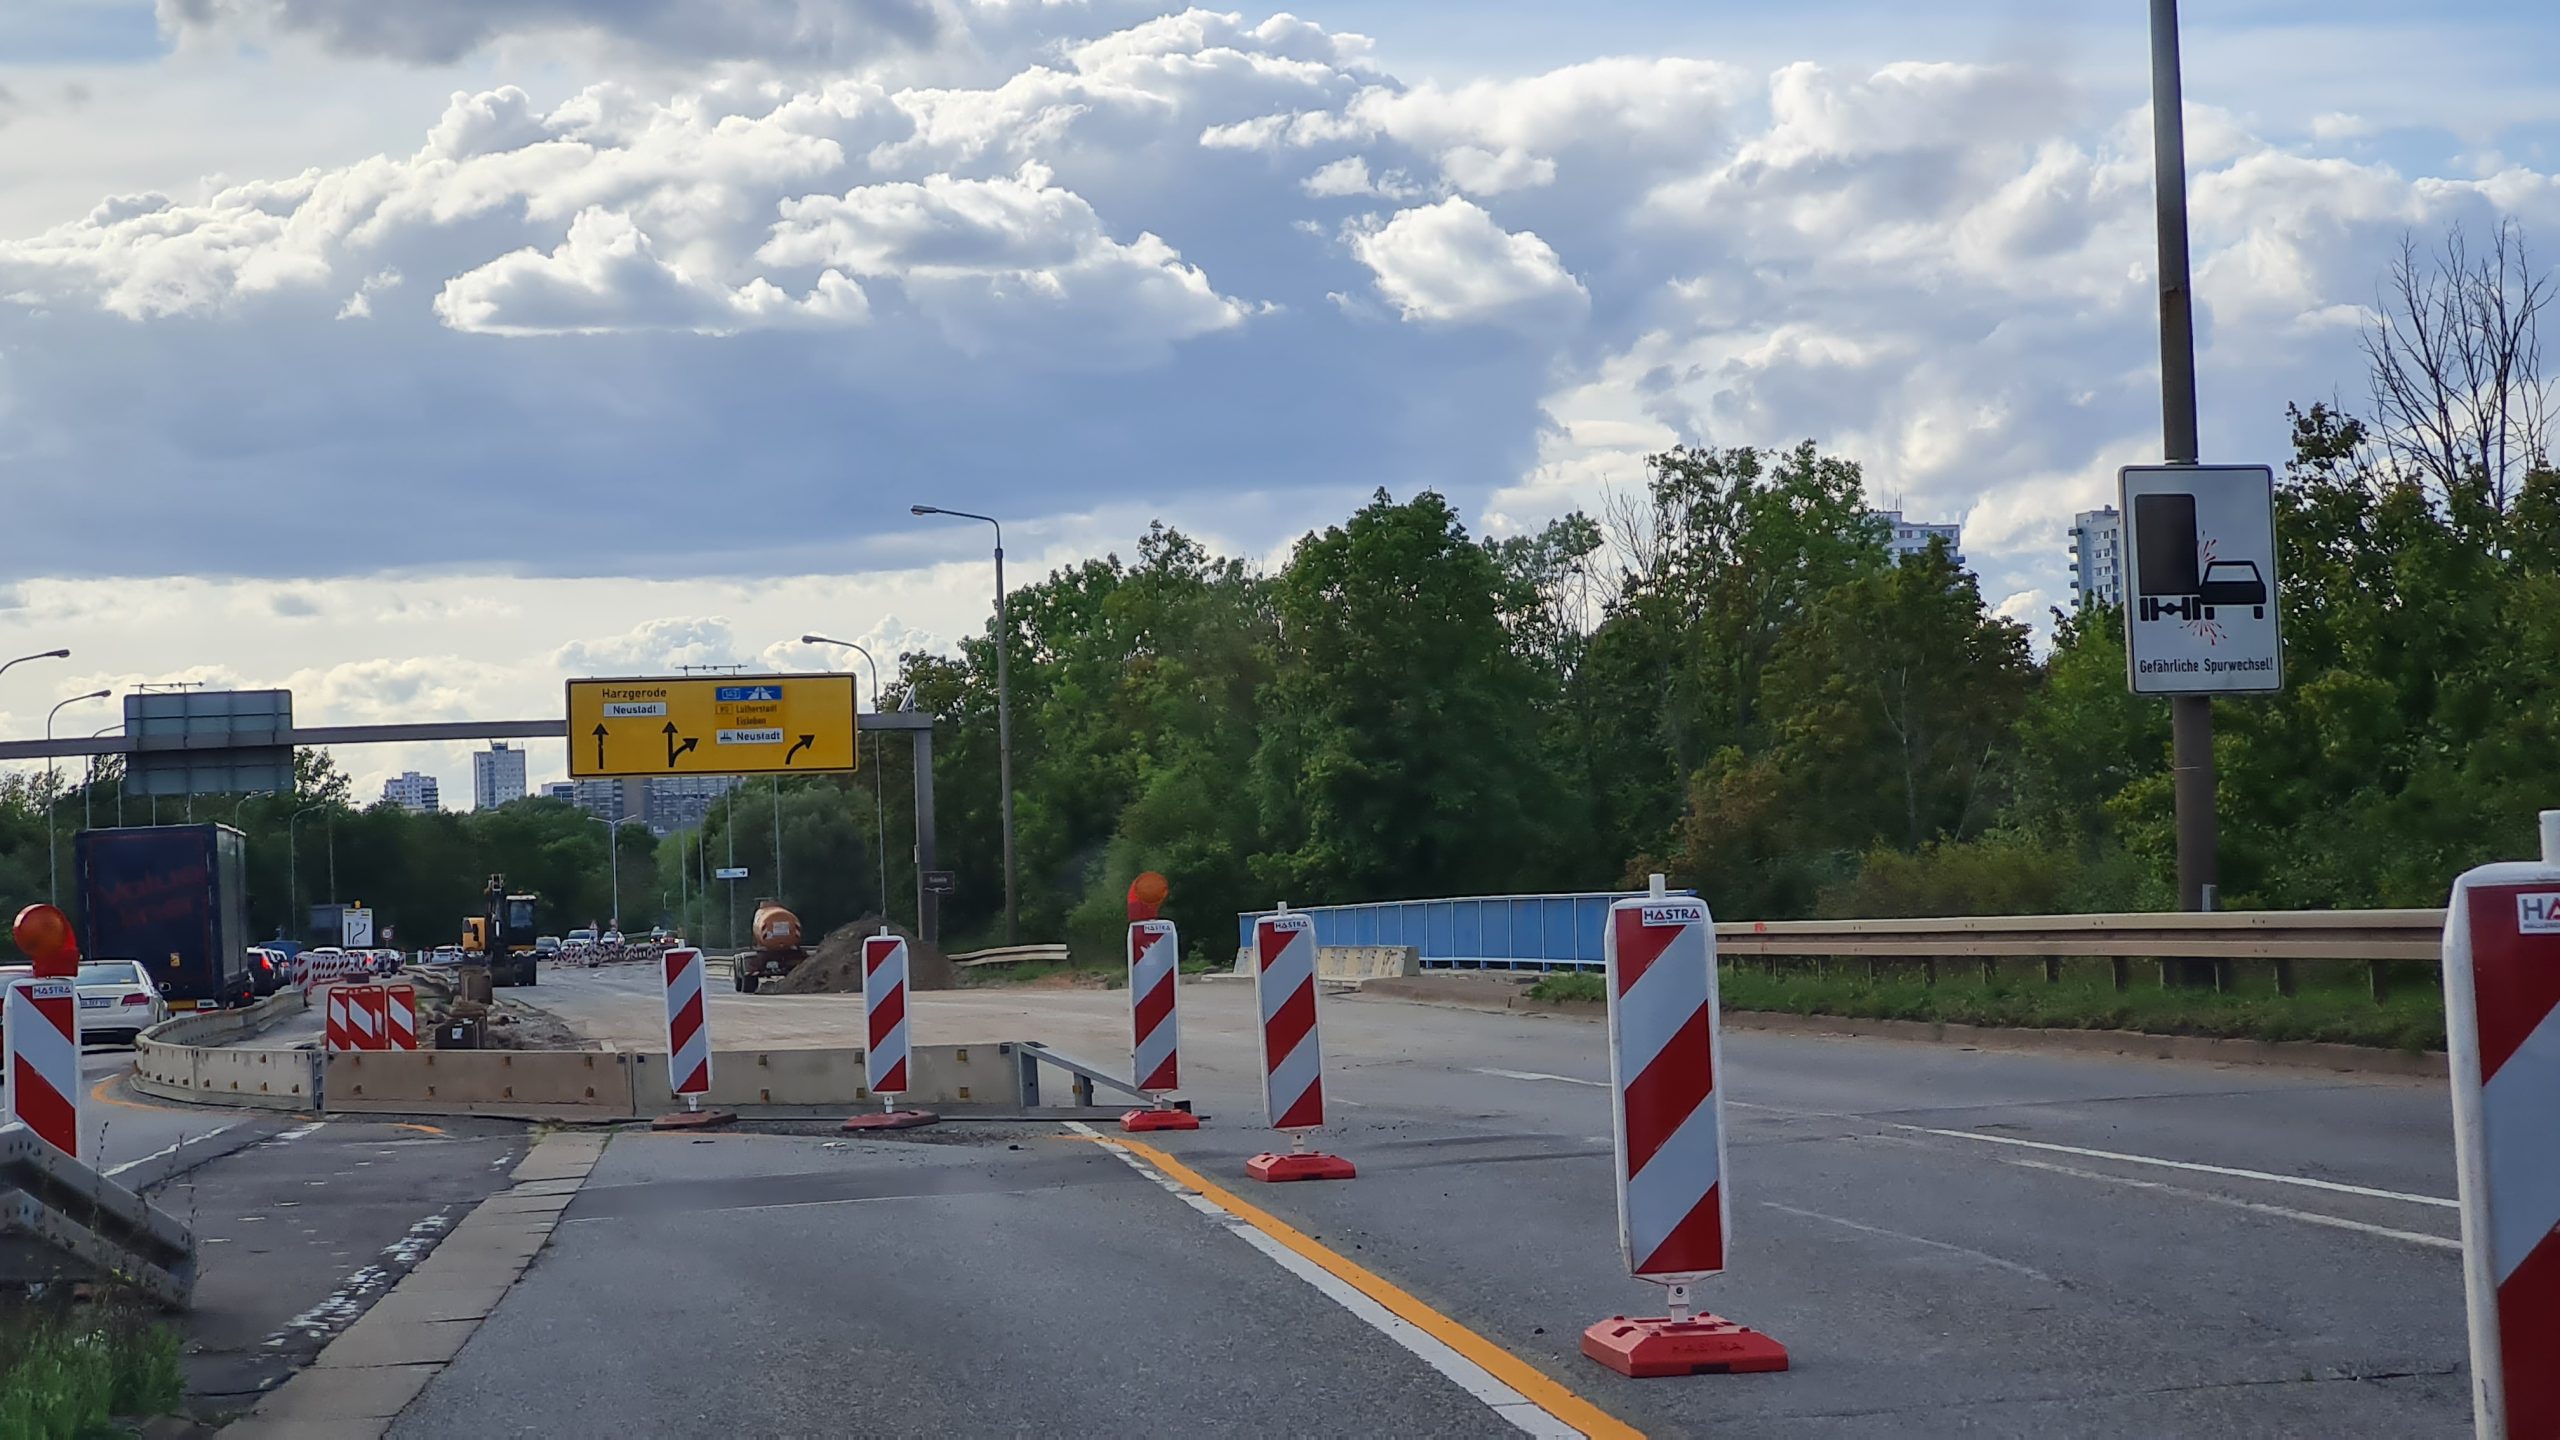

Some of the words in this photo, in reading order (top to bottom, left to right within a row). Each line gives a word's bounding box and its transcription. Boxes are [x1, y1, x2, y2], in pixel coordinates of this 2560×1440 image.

[2139, 658, 2199, 674] Gefährliche
[2204, 657, 2273, 675] Spurwechsel!
[602, 687, 667, 701] Harzgerode
[613, 704, 656, 714] Neustadt
[736, 731, 781, 741] Neustadt
[1644, 908, 1700, 920] HASTRA
[1275, 920, 1308, 929] HASTRA
[34, 985, 71, 995] HASTRA
